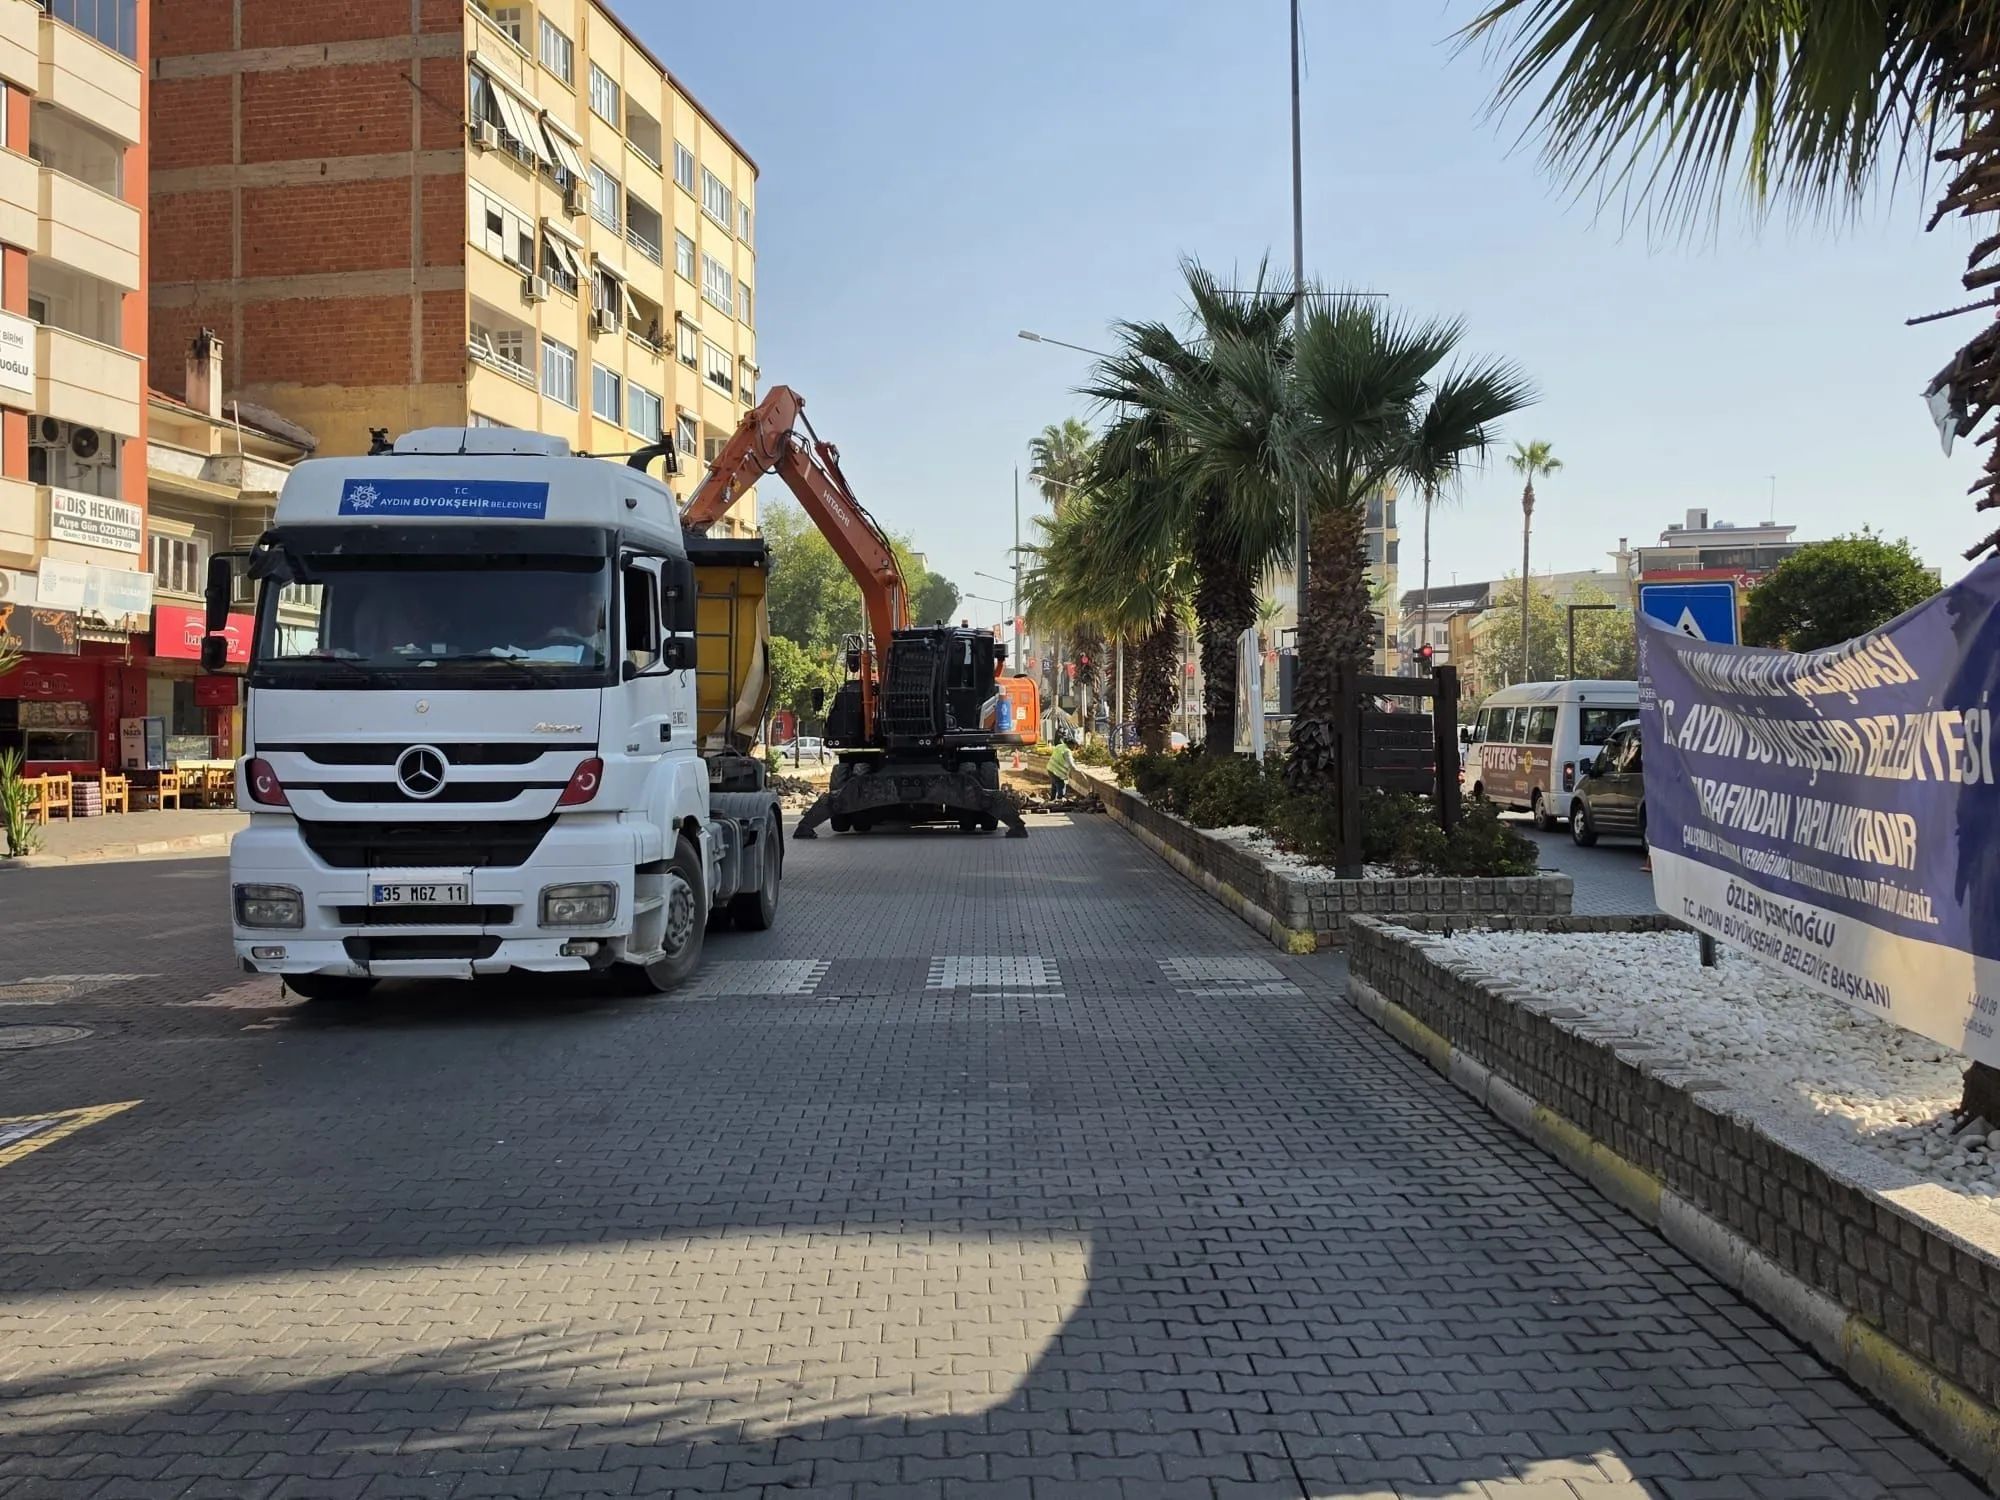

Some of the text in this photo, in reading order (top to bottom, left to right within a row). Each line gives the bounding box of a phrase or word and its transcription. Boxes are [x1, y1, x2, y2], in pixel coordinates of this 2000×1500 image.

[0, 359, 29, 376] UOĞLU
[67, 496, 129, 525] DİŞ HEKİMİ
[380, 497, 542, 510] AYDIN BÜYÜKŞEHİR BELEDİYESİ
[823, 490, 850, 527] HITACHI
[58, 516, 137, 539] Ayşe Gün ÖZDEMİR
[1678, 704, 1743, 758] AYDIN
[1854, 690, 1995, 785] BELEDİYESİ
[1482, 747, 1517, 771] FUTEKS
[1793, 795, 1917, 870] YAPILMAKTADIR
[383, 886, 401, 901] 35
[410, 886, 436, 901] MGZ
[447, 886, 462, 901] 11
[1726, 878, 1836, 948] ÖZLEM ÇERÇİOĞLU
[1683, 897, 1891, 1009] T.C. AYDIN BÜYÜKŞEHİR BELEDİYE BAŞKANI
